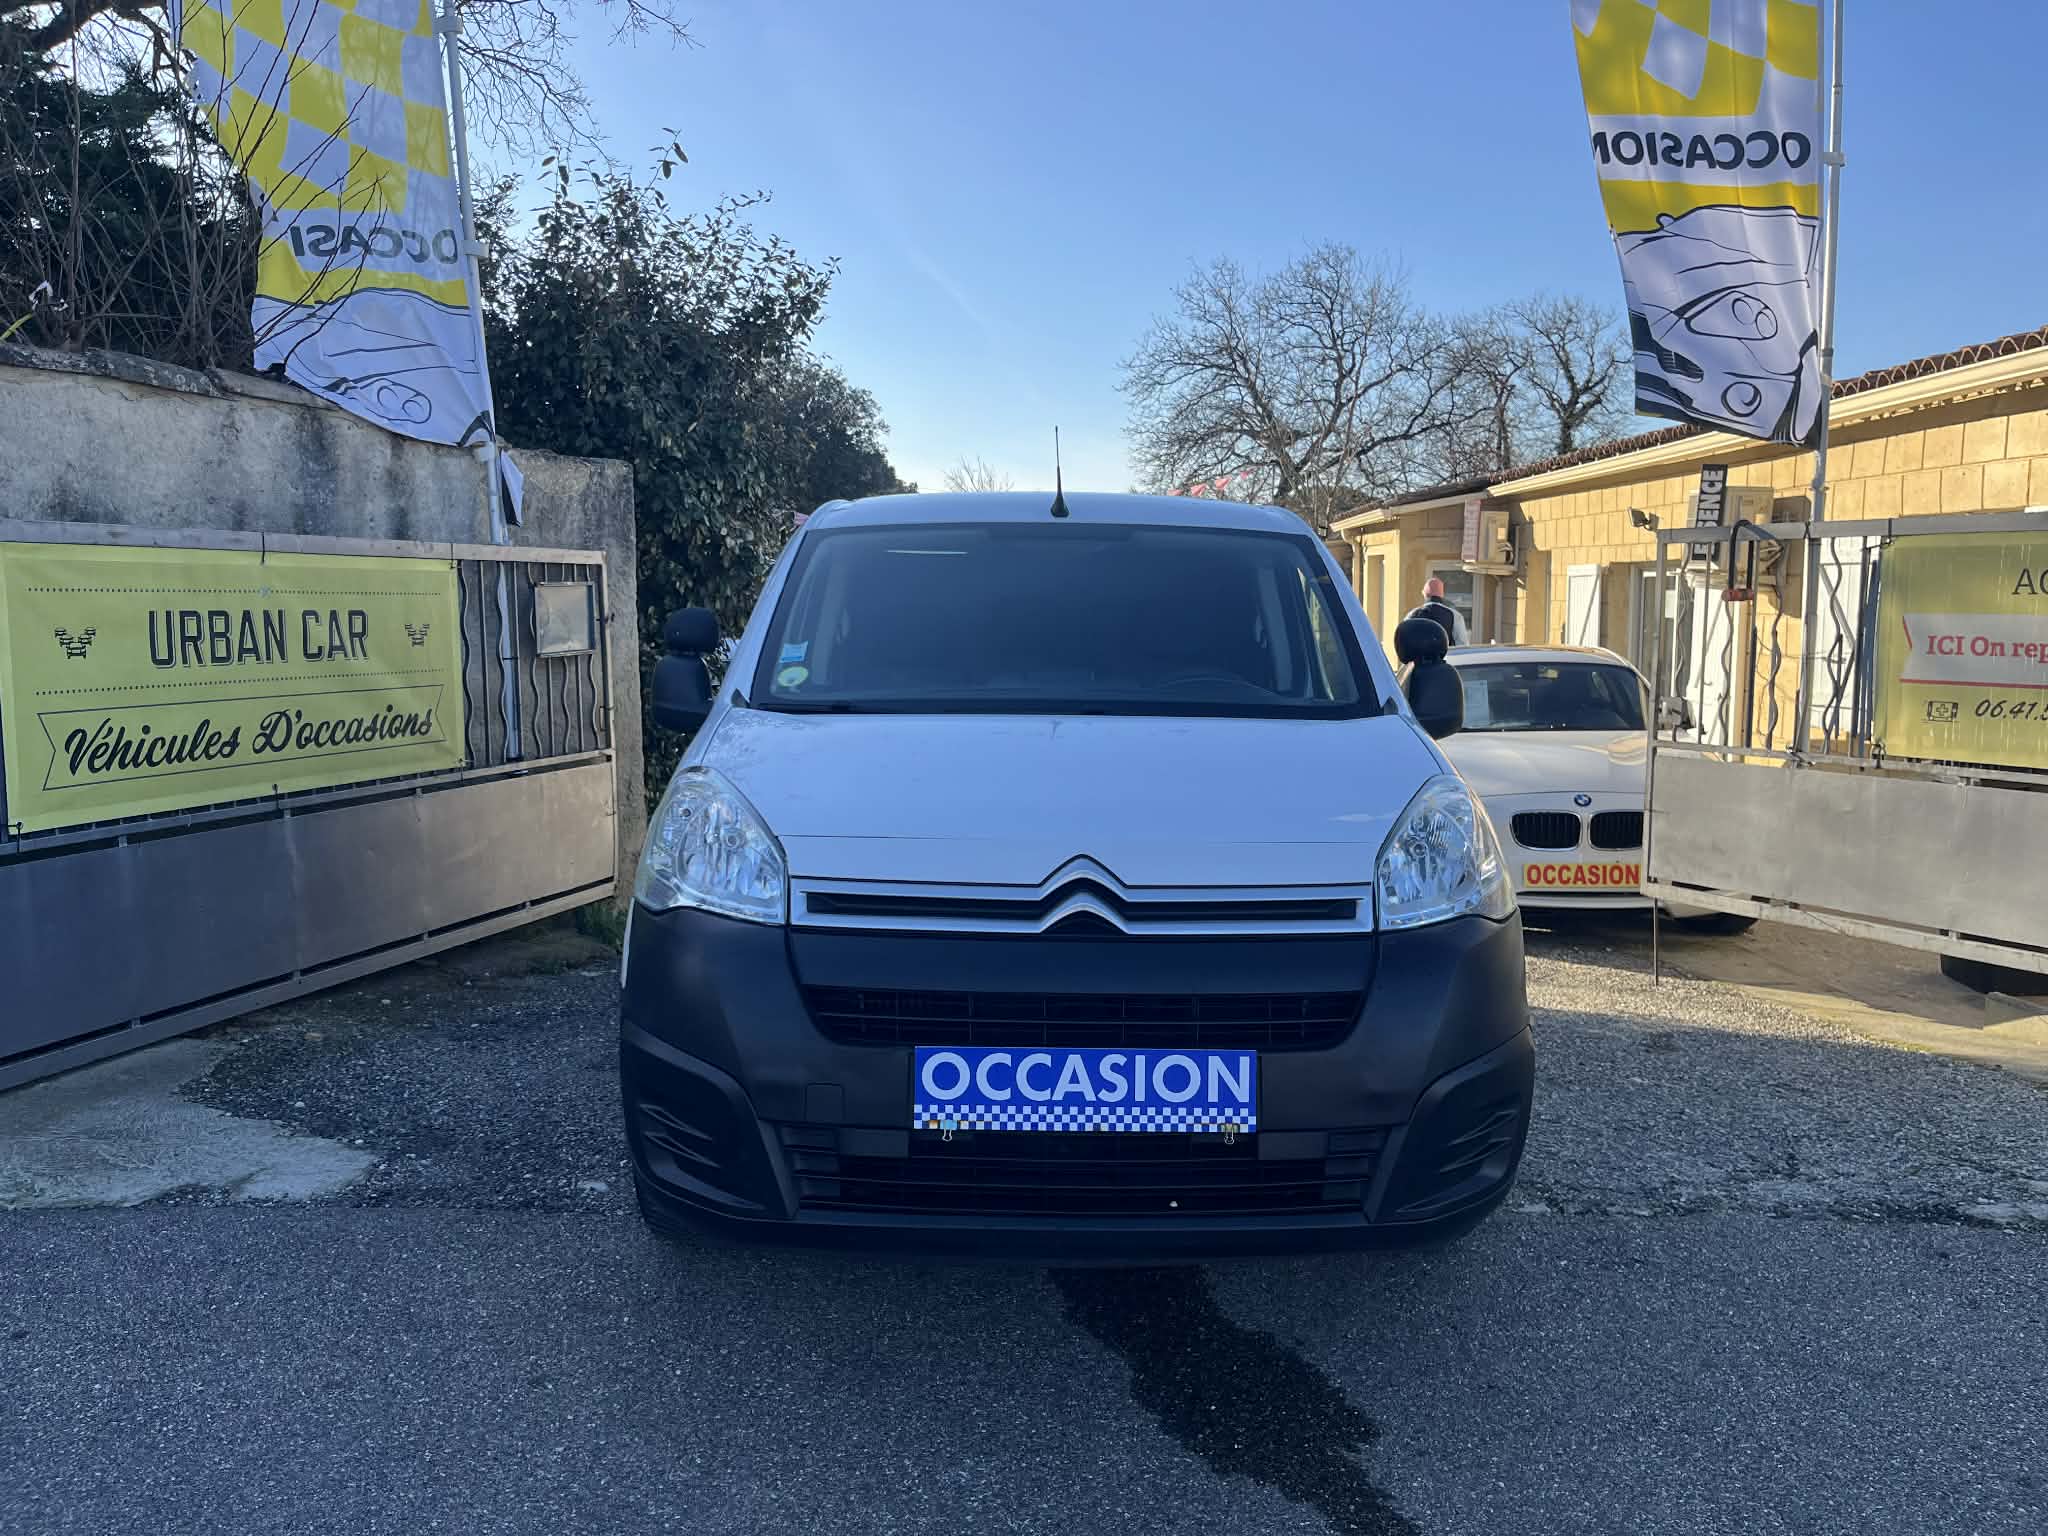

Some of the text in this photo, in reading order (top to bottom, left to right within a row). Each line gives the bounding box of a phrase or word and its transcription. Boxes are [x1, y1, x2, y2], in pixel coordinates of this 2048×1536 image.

[148, 608, 369, 669] URBAN CAR
[1926, 635, 1965, 656] ICI
[1970, 636, 2006, 657] On
[64, 703, 433, 777] Véhicules D'occasions
[1528, 865, 1639, 884] OCCASION
[921, 1051, 1250, 1103] OCCASION
